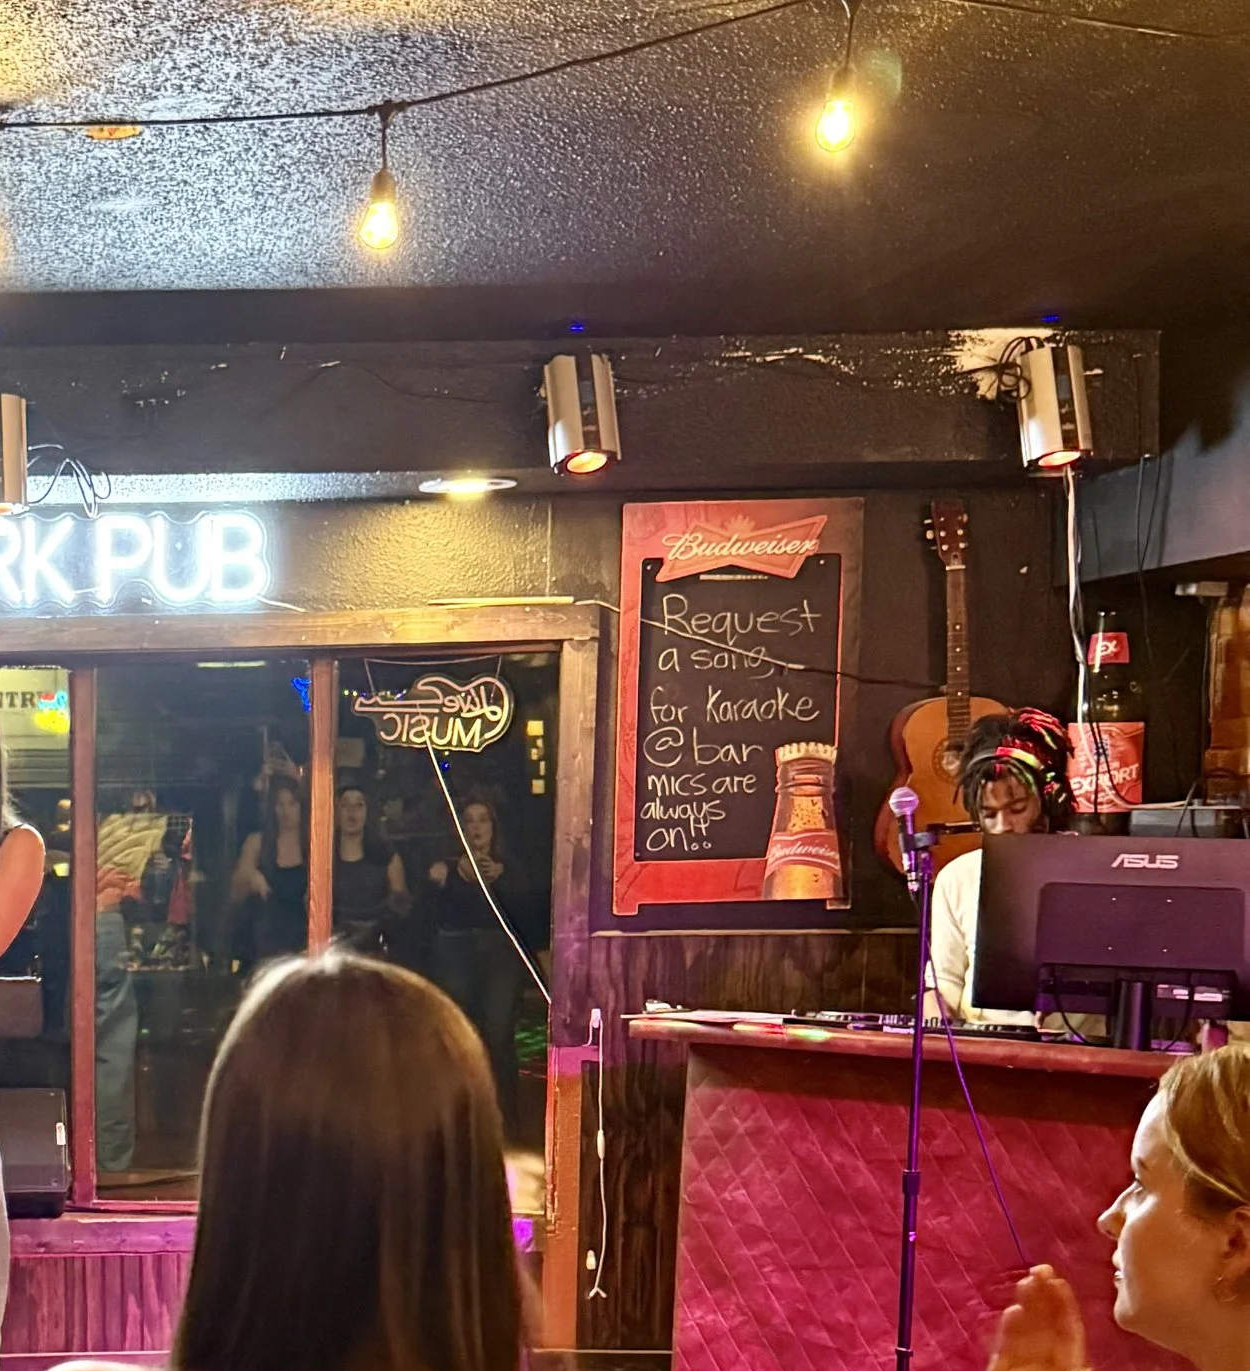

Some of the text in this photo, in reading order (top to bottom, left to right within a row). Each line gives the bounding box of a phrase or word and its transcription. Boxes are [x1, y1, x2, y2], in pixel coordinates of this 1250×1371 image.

[97, 512, 268, 605] PUB
[662, 532, 818, 560] Budweiser
[662, 593, 822, 645] Request
[658, 646, 775, 679] a song
[650, 686, 688, 724] for
[648, 772, 757, 797] mics are
[640, 797, 726, 824] always
[1111, 853, 1180, 869] ASUS
